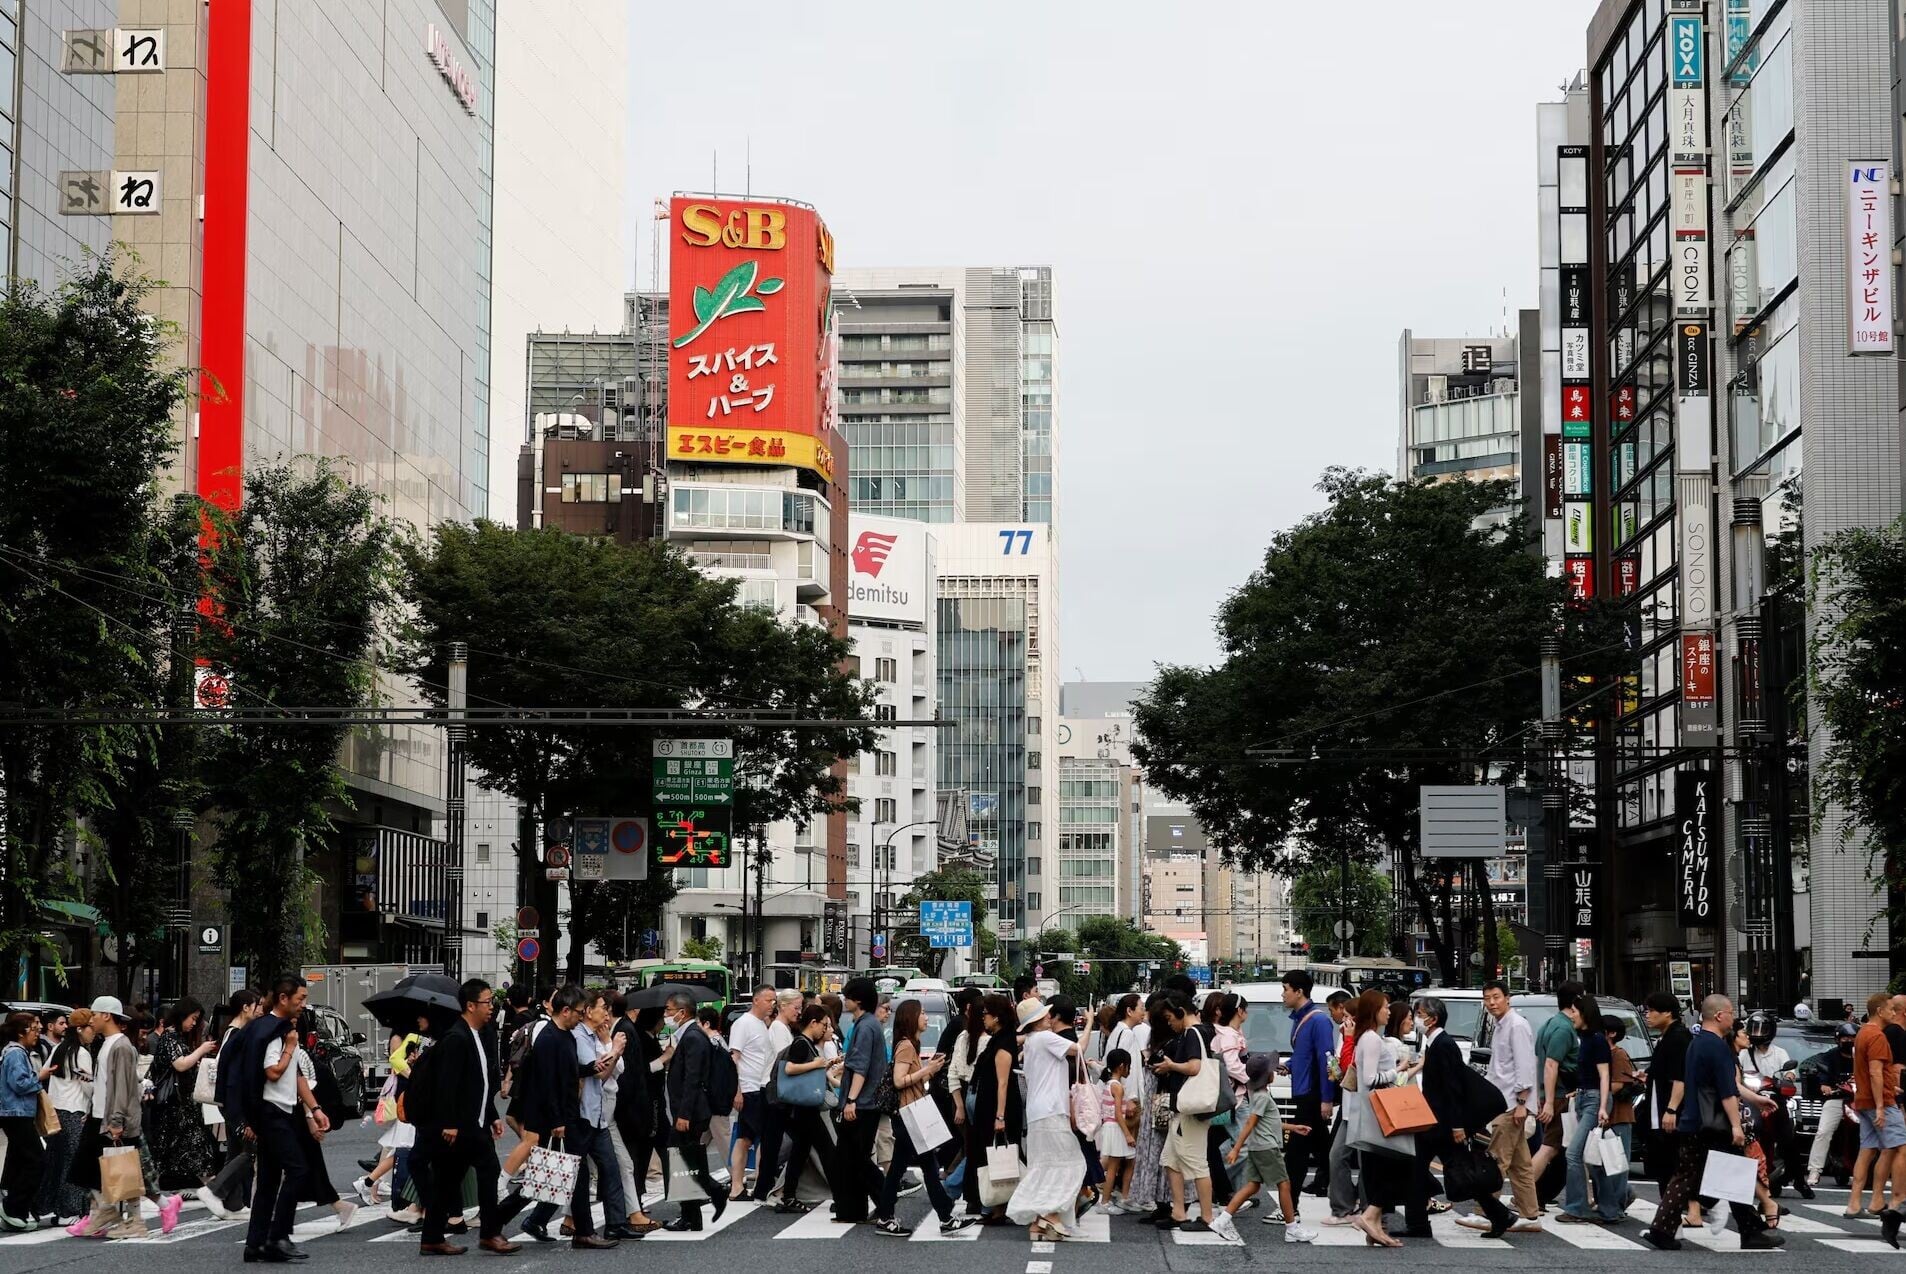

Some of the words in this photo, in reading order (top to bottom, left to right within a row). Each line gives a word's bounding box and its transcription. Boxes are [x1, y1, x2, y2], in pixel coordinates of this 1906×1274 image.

[122, 35, 159, 66] わ
[1679, 24, 1695, 75] NOVA
[1681, 94, 1696, 148] 大月真珠
[120, 176, 154, 208] ね
[682, 204, 787, 250] S&B
[1860, 189, 1882, 322] ニューギンザビル
[1683, 247, 1699, 302] C'BON
[1575, 334, 1585, 372] カツミ堂
[1856, 330, 1888, 343] 10号館
[688, 343, 779, 380] スパイス
[1688, 353, 1698, 388] GINZA
[729, 373, 750, 393] &
[1687, 389, 1699, 397] 4F
[707, 384, 776, 418] ハーブ
[677, 434, 786, 458] エスビー食品
[1582, 445, 1589, 454] Le
[999, 530, 1034, 555] 77
[1688, 523, 1706, 613] SONOKO
[1686, 647, 1697, 692] ステーキ
[1697, 639, 1711, 675] 銀座の
[1690, 701, 1708, 709] B1F
[670, 793, 690, 801] 500m
[694, 793, 714, 801] 500m
[693, 841, 702, 849] C1
[1695, 781, 1709, 917] KATSUMIDO
[1682, 820, 1694, 910] CAMERA
[1574, 869, 1592, 926] 山形屋
